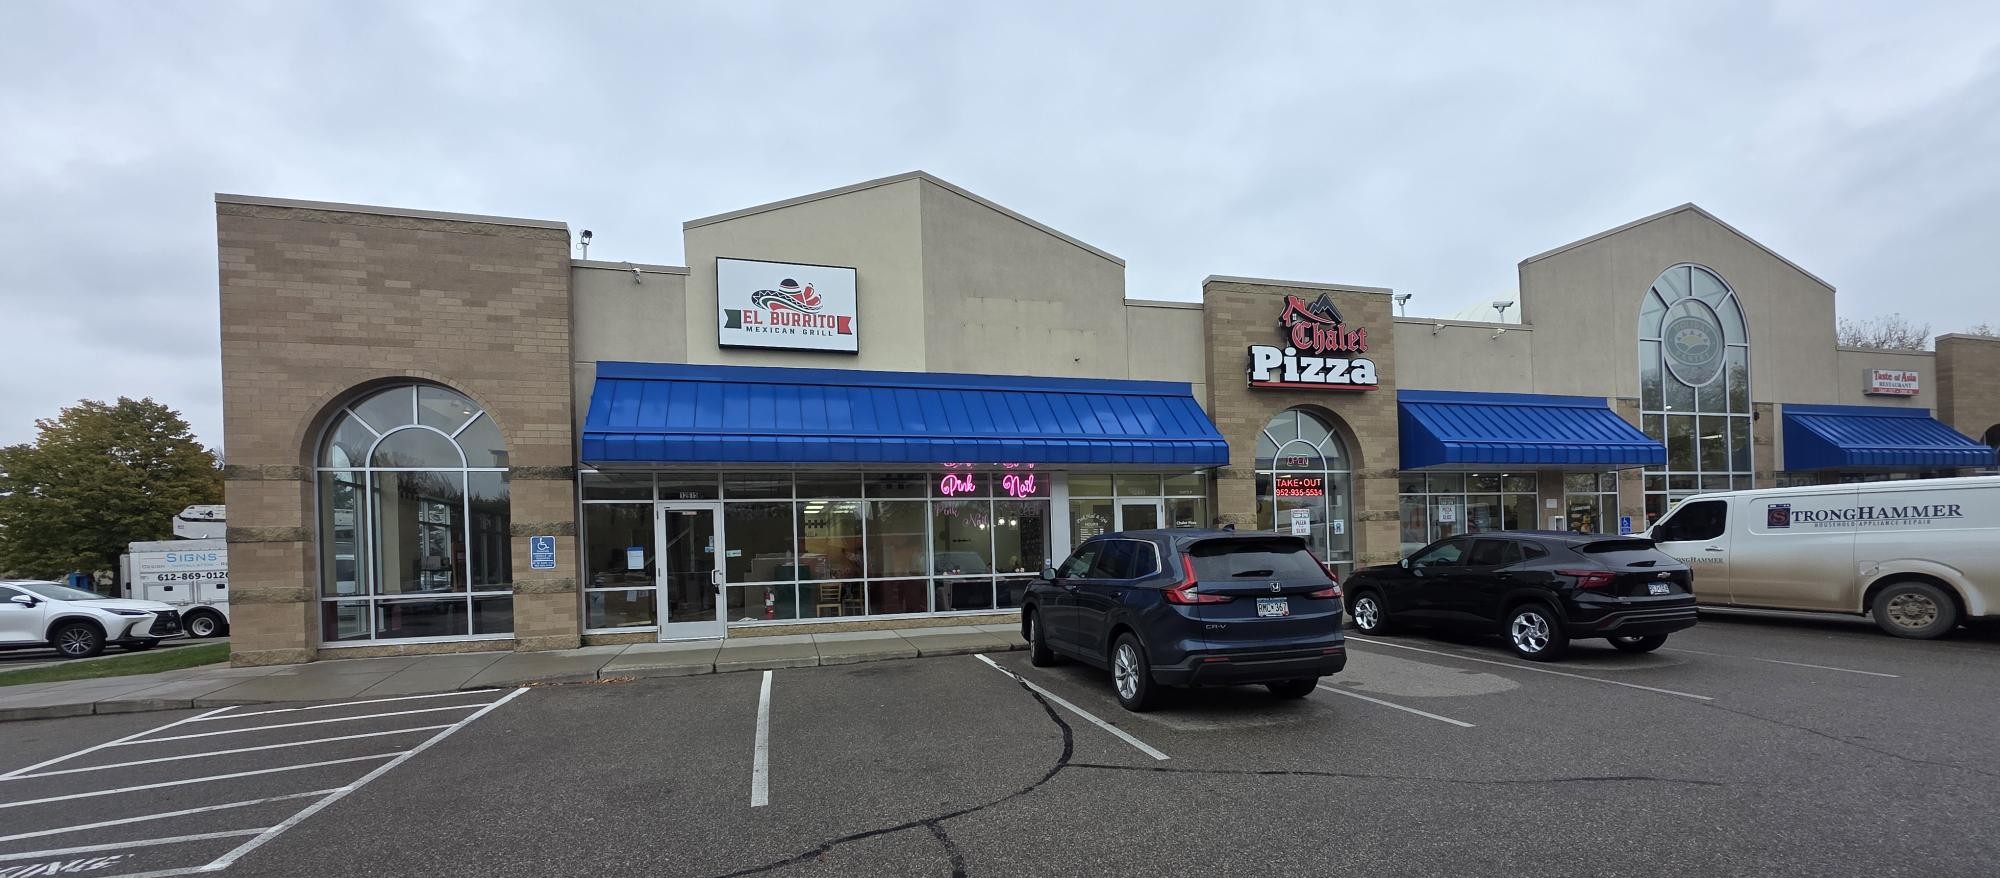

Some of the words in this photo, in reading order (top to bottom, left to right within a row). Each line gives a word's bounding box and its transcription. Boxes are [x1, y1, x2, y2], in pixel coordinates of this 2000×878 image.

[743, 310, 763, 325] EL
[769, 311, 836, 329] BURRITO
[745, 326, 796, 335] MEXICAN
[802, 329, 834, 337] GRILL
[1291, 320, 1369, 355] Chalet
[1251, 345, 1378, 384] Pizza
[1873, 370, 1893, 381] Taste
[1901, 372, 1917, 382] Asia
[1287, 456, 1308, 465] OPEN
[941, 474, 976, 496] Pink
[1003, 474, 1036, 498] Nail
[1858, 519, 1899, 527] APPLIANCE
[1903, 518, 1931, 526] REPAIR
[166, 553, 217, 563] SIGNS
